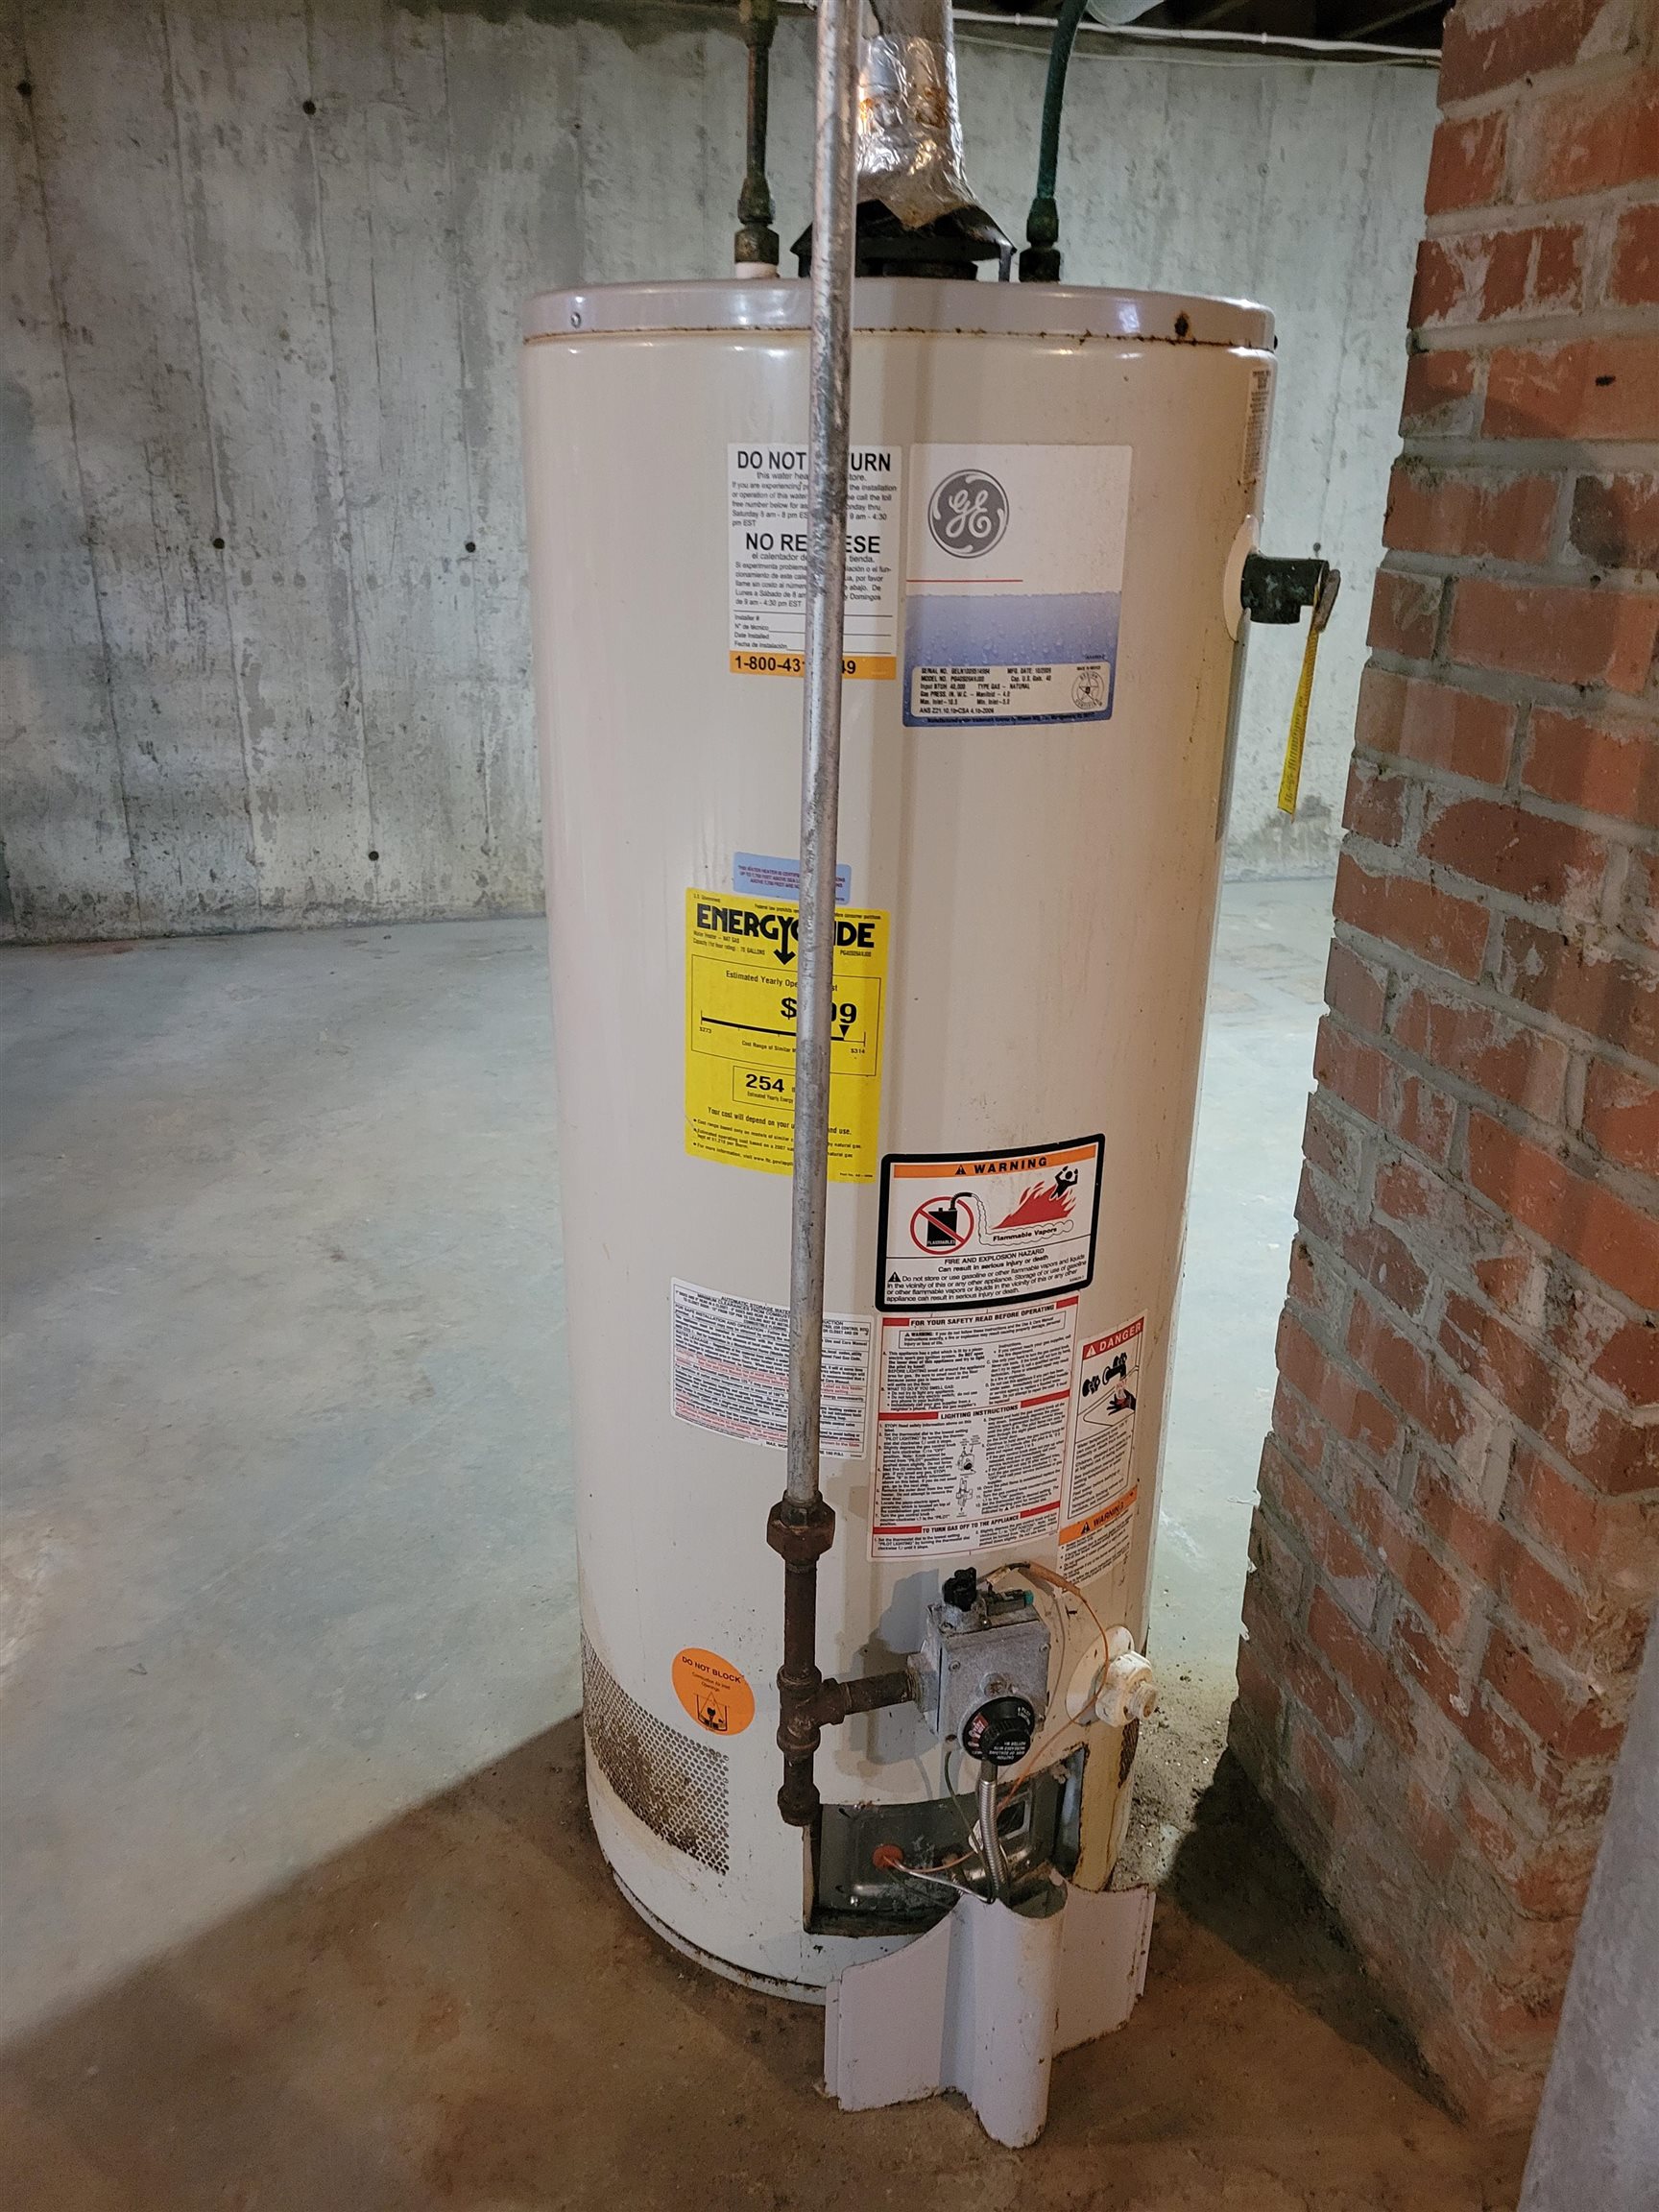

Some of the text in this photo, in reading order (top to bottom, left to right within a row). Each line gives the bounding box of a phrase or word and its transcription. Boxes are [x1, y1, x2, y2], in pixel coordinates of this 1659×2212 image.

[737, 450, 891, 471] DO NOT URN
[746, 532, 774, 551] NO
[759, 552, 798, 562] calentador
[726, 970, 758, 982] Estimated
[760, 975, 783, 987] Yearly
[745, 1073, 784, 1093] 254
[708, 1106, 720, 1115] Your
[721, 1110, 733, 1118] cost
[733, 1112, 744, 1120] will
[745, 1115, 766, 1125] depend
[777, 1120, 789, 1129] your
[974, 1157, 1047, 1174] WARNING
[993, 1227, 1057, 1241] Flammable Vapors
[978, 1252, 1017, 1262] EXPLOSION
[1018, 1248, 1045, 1257] HAZARD
[1005, 1259, 1023, 1267] injury
[961, 1272, 986, 1281] gasoline
[1011, 1265, 1040, 1275] flammable
[1015, 1272, 1036, 1281] Storage
[995, 1311, 1020, 1320] BEFORE
[1021, 1305, 1055, 1316] OPERATING
[1099, 1322, 1142, 1352] DANGER
[973, 1405, 1018, 1417] INSTRUCTIONS
[991, 1515, 1019, 1525] APPLIANCE
[682, 1656, 693, 1666] DO
[694, 1662, 710, 1672] NOT
[712, 1669, 741, 1684] BLOCK
